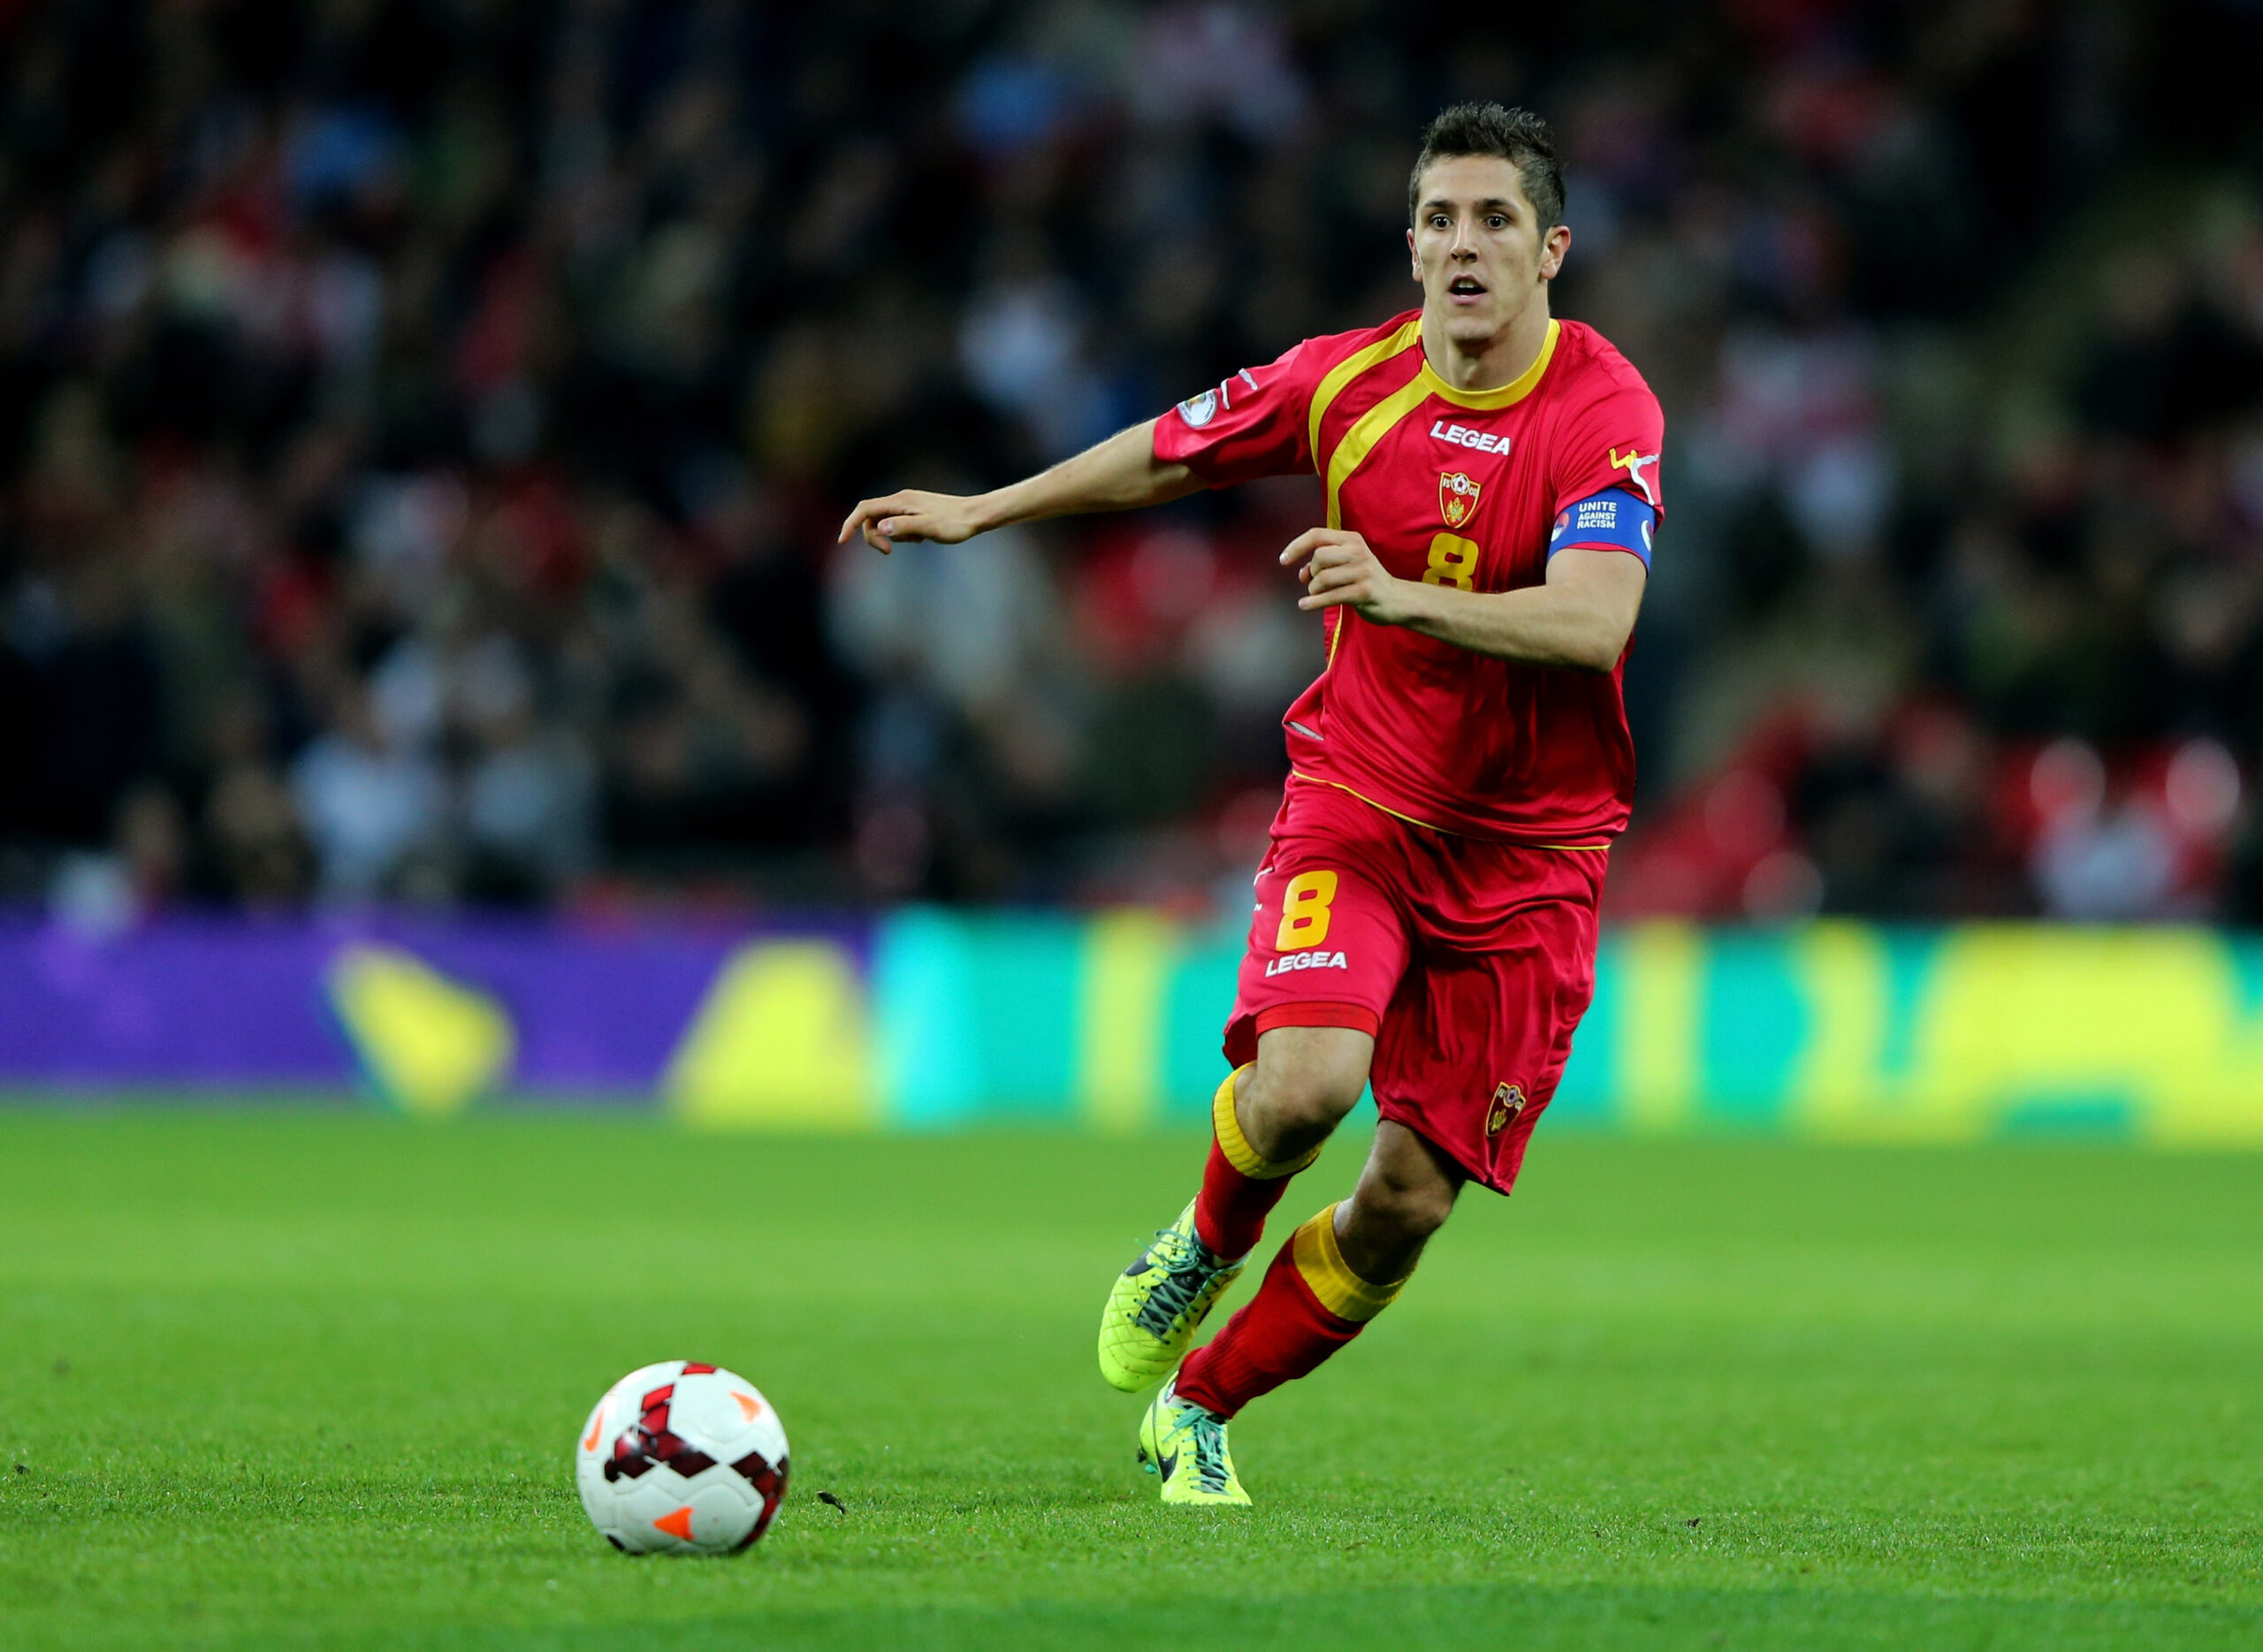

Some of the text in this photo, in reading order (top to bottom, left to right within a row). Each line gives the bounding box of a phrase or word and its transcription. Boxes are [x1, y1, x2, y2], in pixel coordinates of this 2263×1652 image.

[1429, 420, 1511, 456] LEGEA
[1578, 512, 1616, 521] AGAINST
[1579, 501, 1617, 512] UNITE
[1576, 520, 1615, 529] RACISM
[1421, 532, 1479, 591] 8
[1276, 870, 1337, 952] 8
[1265, 951, 1347, 978] LEGEA
